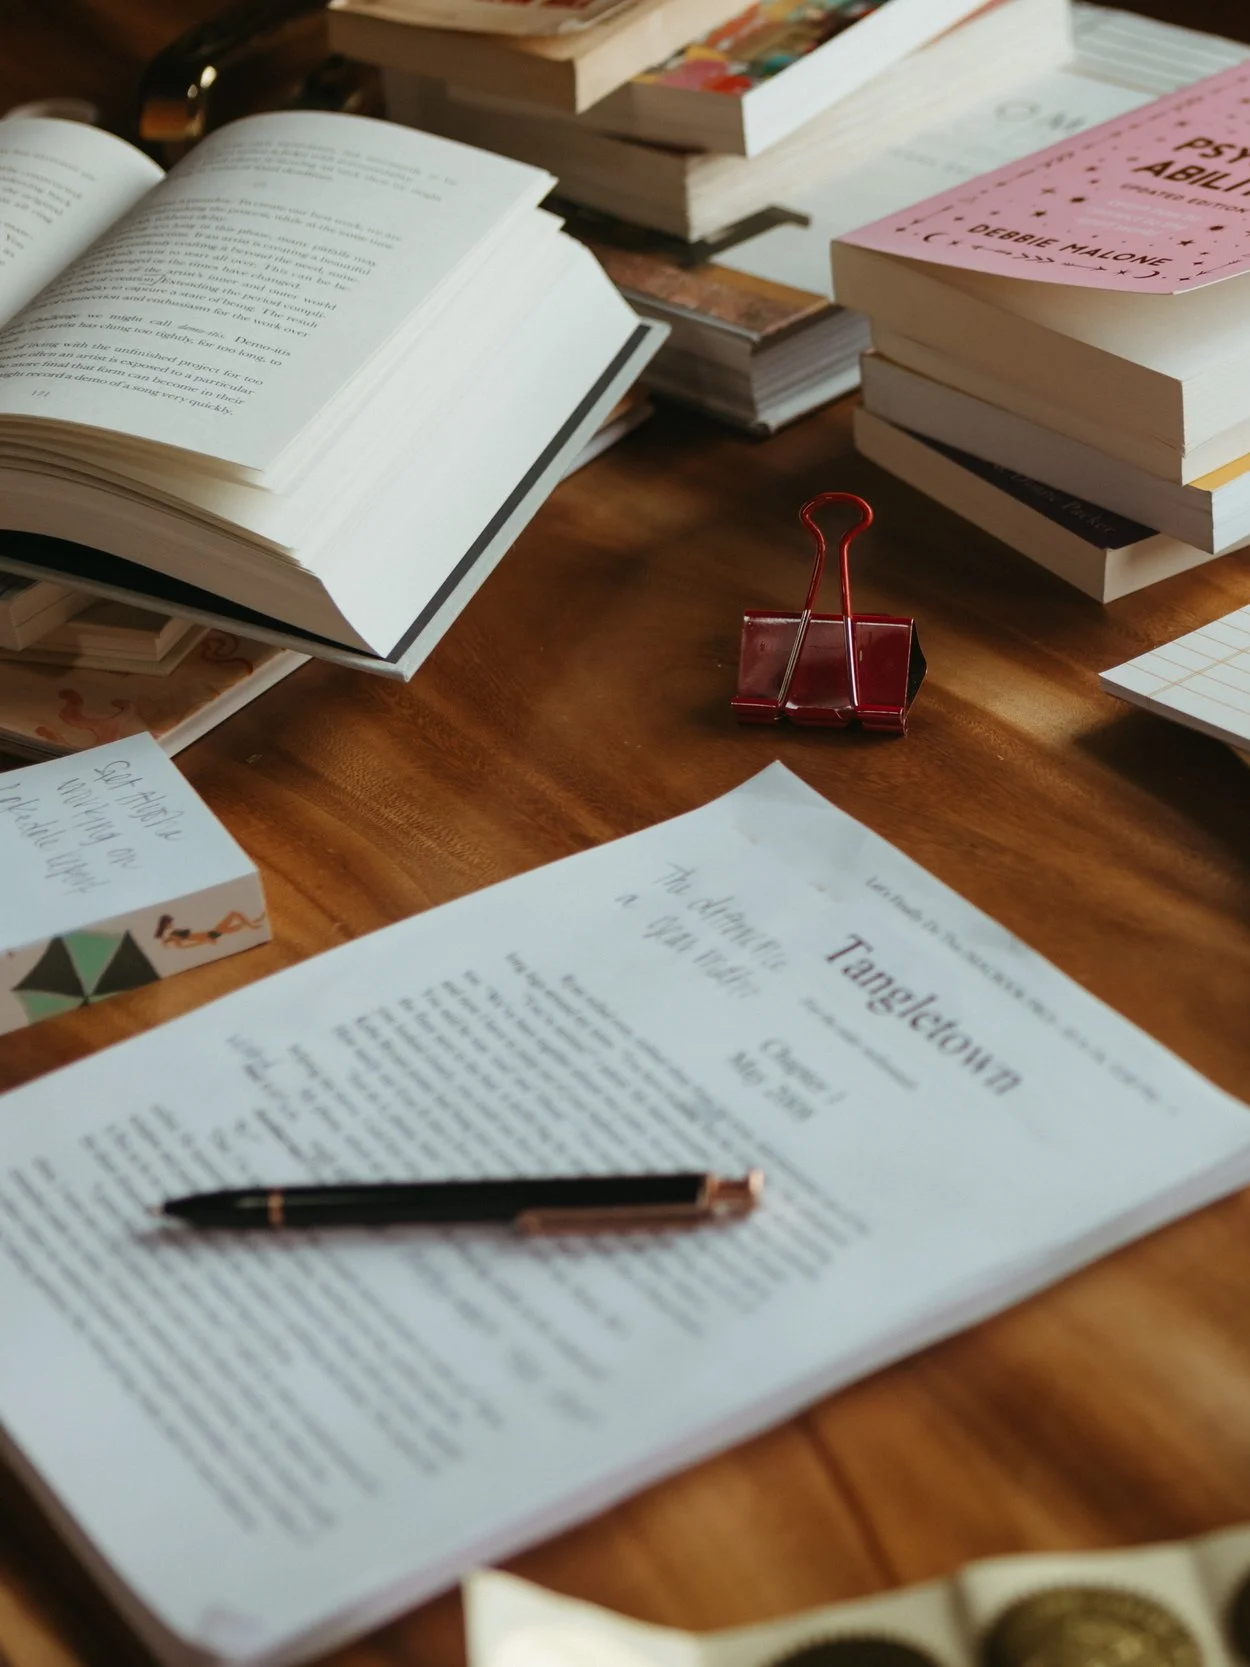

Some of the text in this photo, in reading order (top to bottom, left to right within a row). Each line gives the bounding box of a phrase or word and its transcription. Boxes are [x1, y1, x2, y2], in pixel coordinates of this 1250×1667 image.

[1187, 198, 1250, 214] EDITION
[967, 223, 1174, 267] DEBBIE MALONE
[261, 263, 289, 275] This
[211, 307, 230, 316] for
[230, 312, 251, 321] the
[251, 318, 284, 330] work
[281, 326, 311, 338] over
[259, 307, 285, 319] The
[284, 315, 321, 328] result
[301, 297, 339, 309] world
[97, 323, 132, 333] clung
[132, 327, 154, 335] too
[153, 330, 195, 344] tightly,
[196, 338, 214, 347] for
[215, 343, 237, 354] too
[236, 349, 266, 363] long,
[268, 358, 284, 366] to
[107, 314, 144, 322] might
[147, 319, 173, 327] call
[233, 335, 293, 356] Demo-itis
[89, 342, 113, 350] the
[112, 346, 178, 362] unfinished
[176, 359, 221, 373] project
[221, 368, 241, 379] for
[241, 375, 265, 385] too
[118, 359, 170, 372] exposed
[169, 368, 184, 376] to
[192, 375, 258, 396] particular
[69, 362, 97, 370] that
[96, 365, 127, 376] form
[125, 372, 151, 380] can
[151, 375, 200, 392] become
[199, 388, 215, 396] in
[214, 392, 246, 405] their
[72, 373, 109, 384] demo
[130, 385, 160, 397] song
[159, 392, 186, 404] very
[185, 399, 233, 416] quickly.
[57, 778, 143, 870] working on
[653, 861, 697, 895] The
[613, 893, 641, 908] a
[823, 932, 1023, 1098] Tangletown
